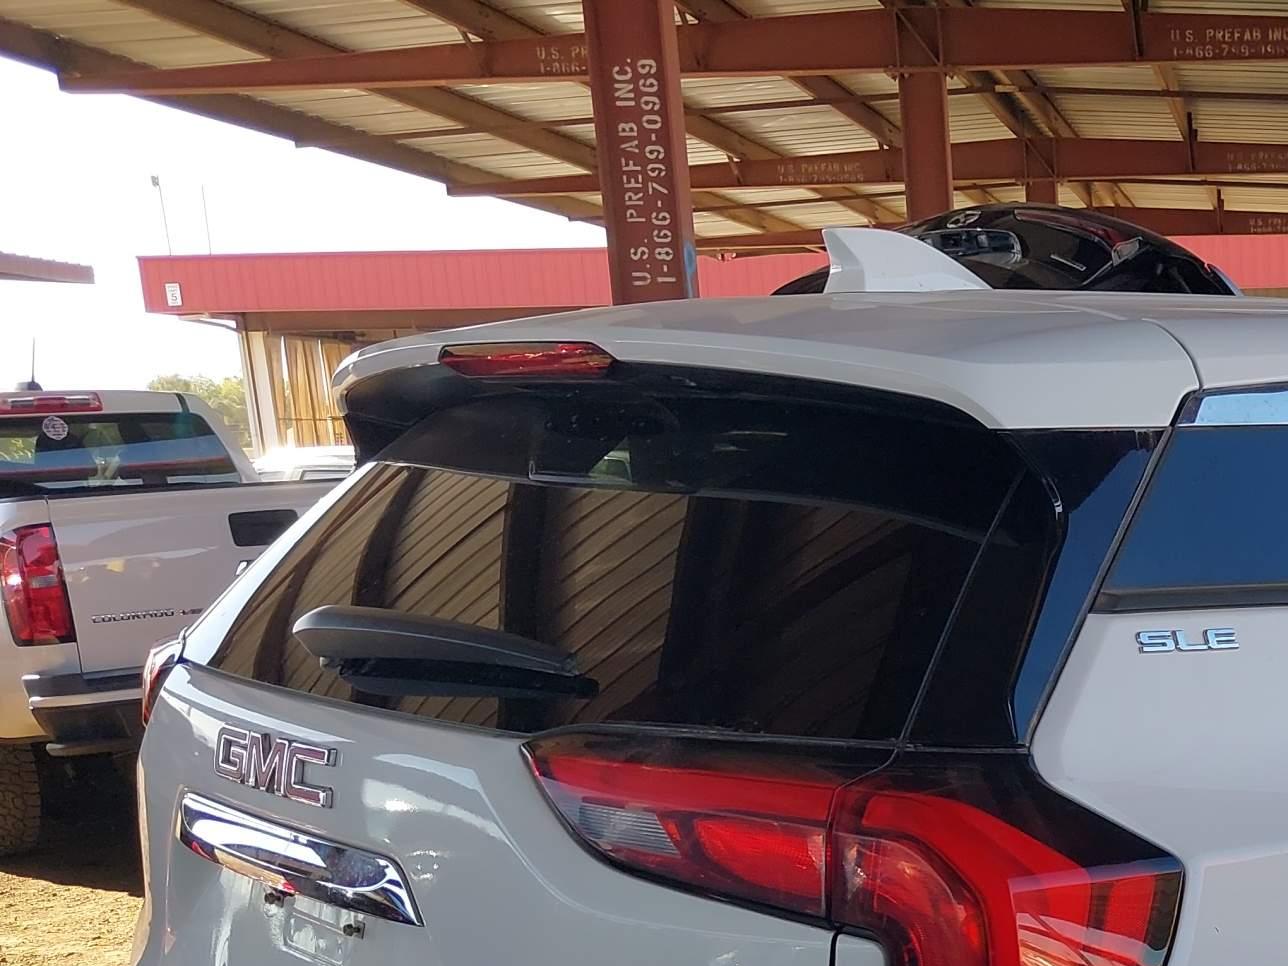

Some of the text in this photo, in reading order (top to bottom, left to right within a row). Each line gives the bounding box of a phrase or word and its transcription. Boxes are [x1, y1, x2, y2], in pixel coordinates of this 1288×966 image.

[1206, 28, 1262, 42] PREFAB
[612, 57, 652, 287] U.S. PREFAB INC.
[636, 57, 677, 284] 1-866-799-0969
[91, 607, 175, 624] COLORADO
[1135, 627, 1240, 654] SLE
[214, 722, 338, 809] GMC
